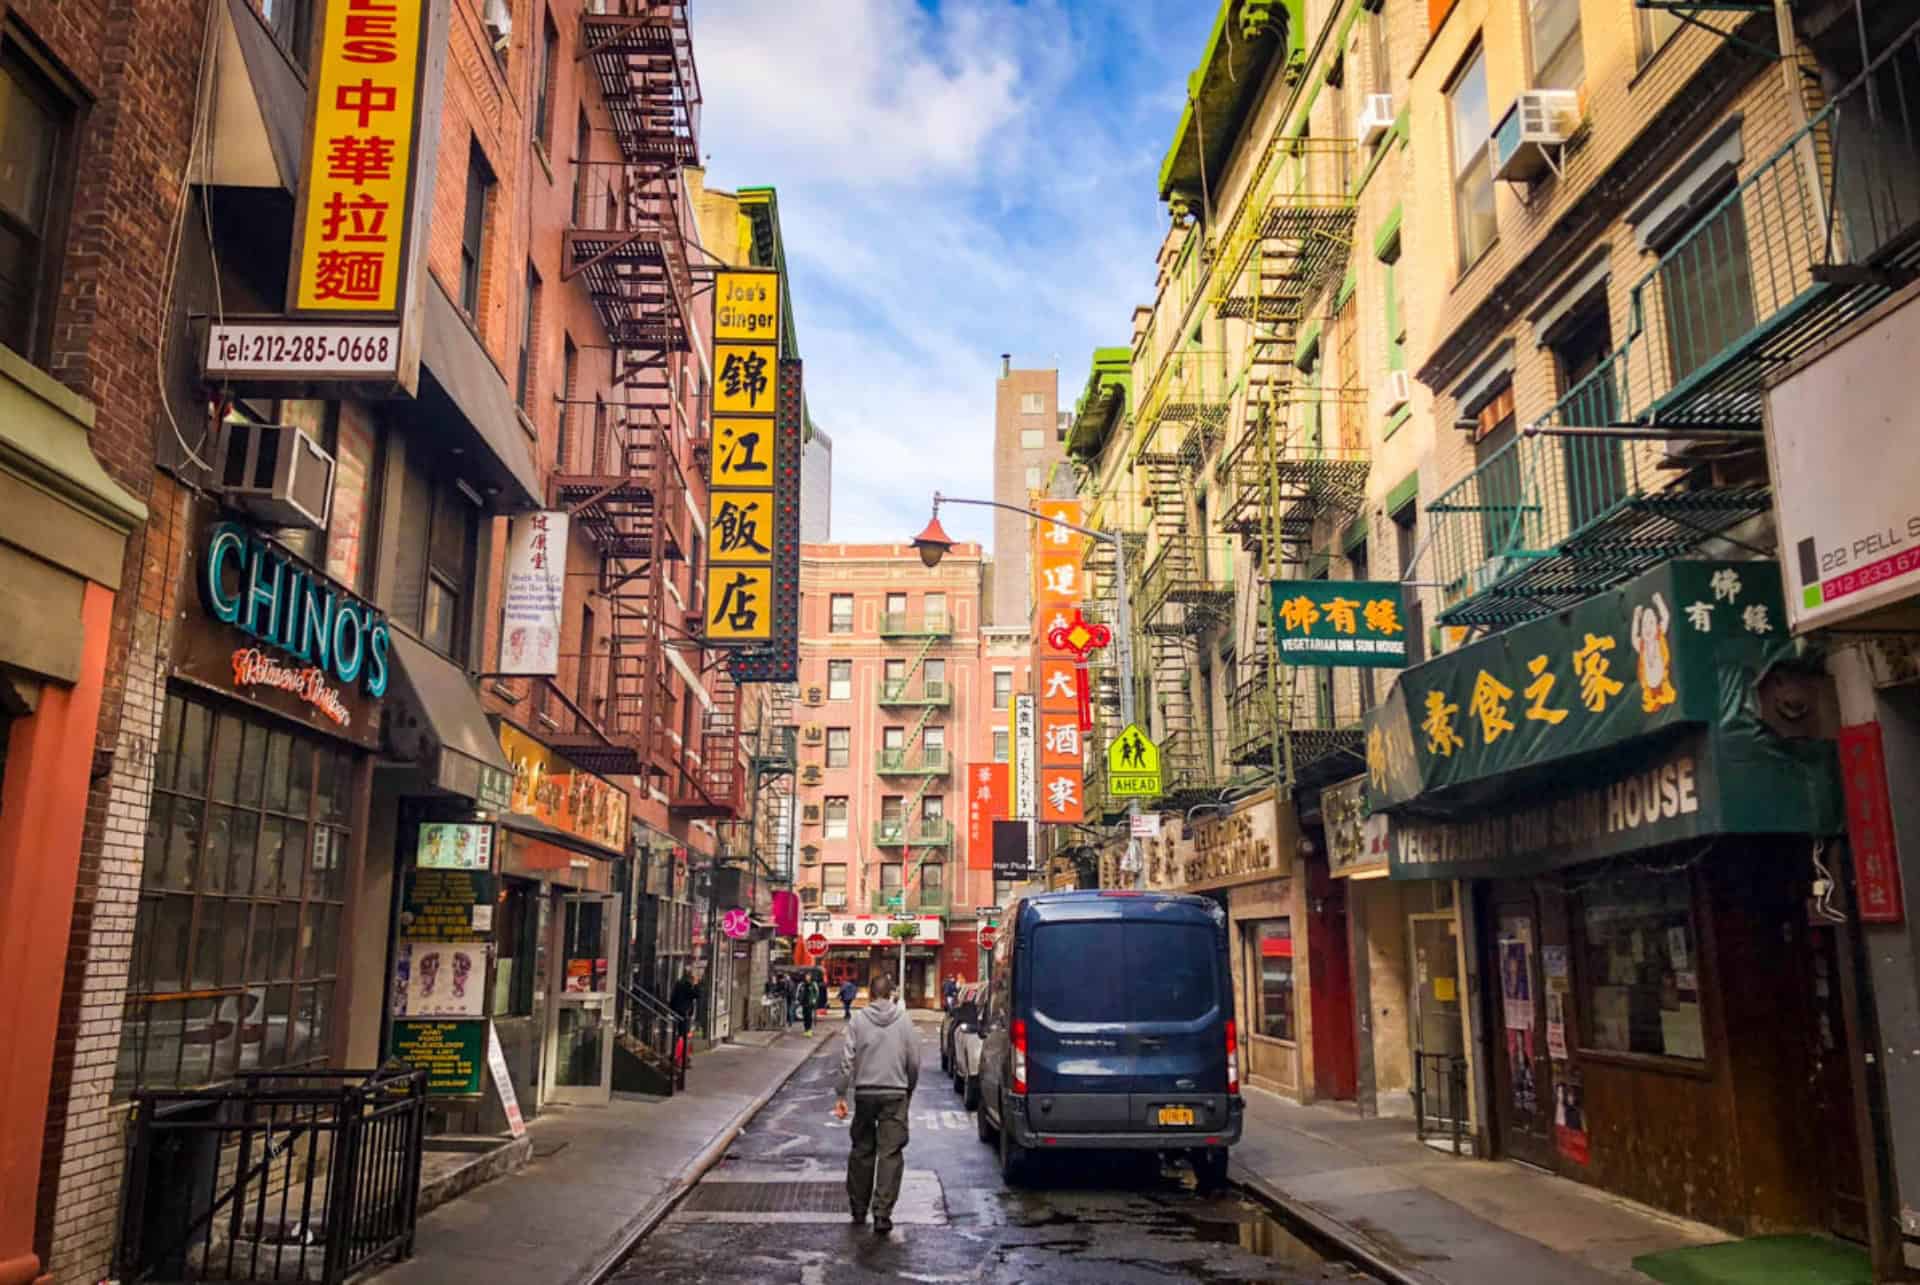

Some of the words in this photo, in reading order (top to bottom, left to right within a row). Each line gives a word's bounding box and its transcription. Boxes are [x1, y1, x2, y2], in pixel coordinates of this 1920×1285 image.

[726, 280, 766, 301] Joe's
[720, 306, 774, 331] Ginger
[711, 350, 770, 632] 錦江飯店
[1821, 547, 1848, 572] 22
[1853, 528, 1902, 559] PELL
[208, 522, 390, 697] CHINO'S
[1279, 596, 1404, 636] 佛有緣
[1421, 633, 1624, 758] 素食之家
[1115, 779, 1156, 792] AHEAD
[1606, 757, 1699, 833] HOUSE
